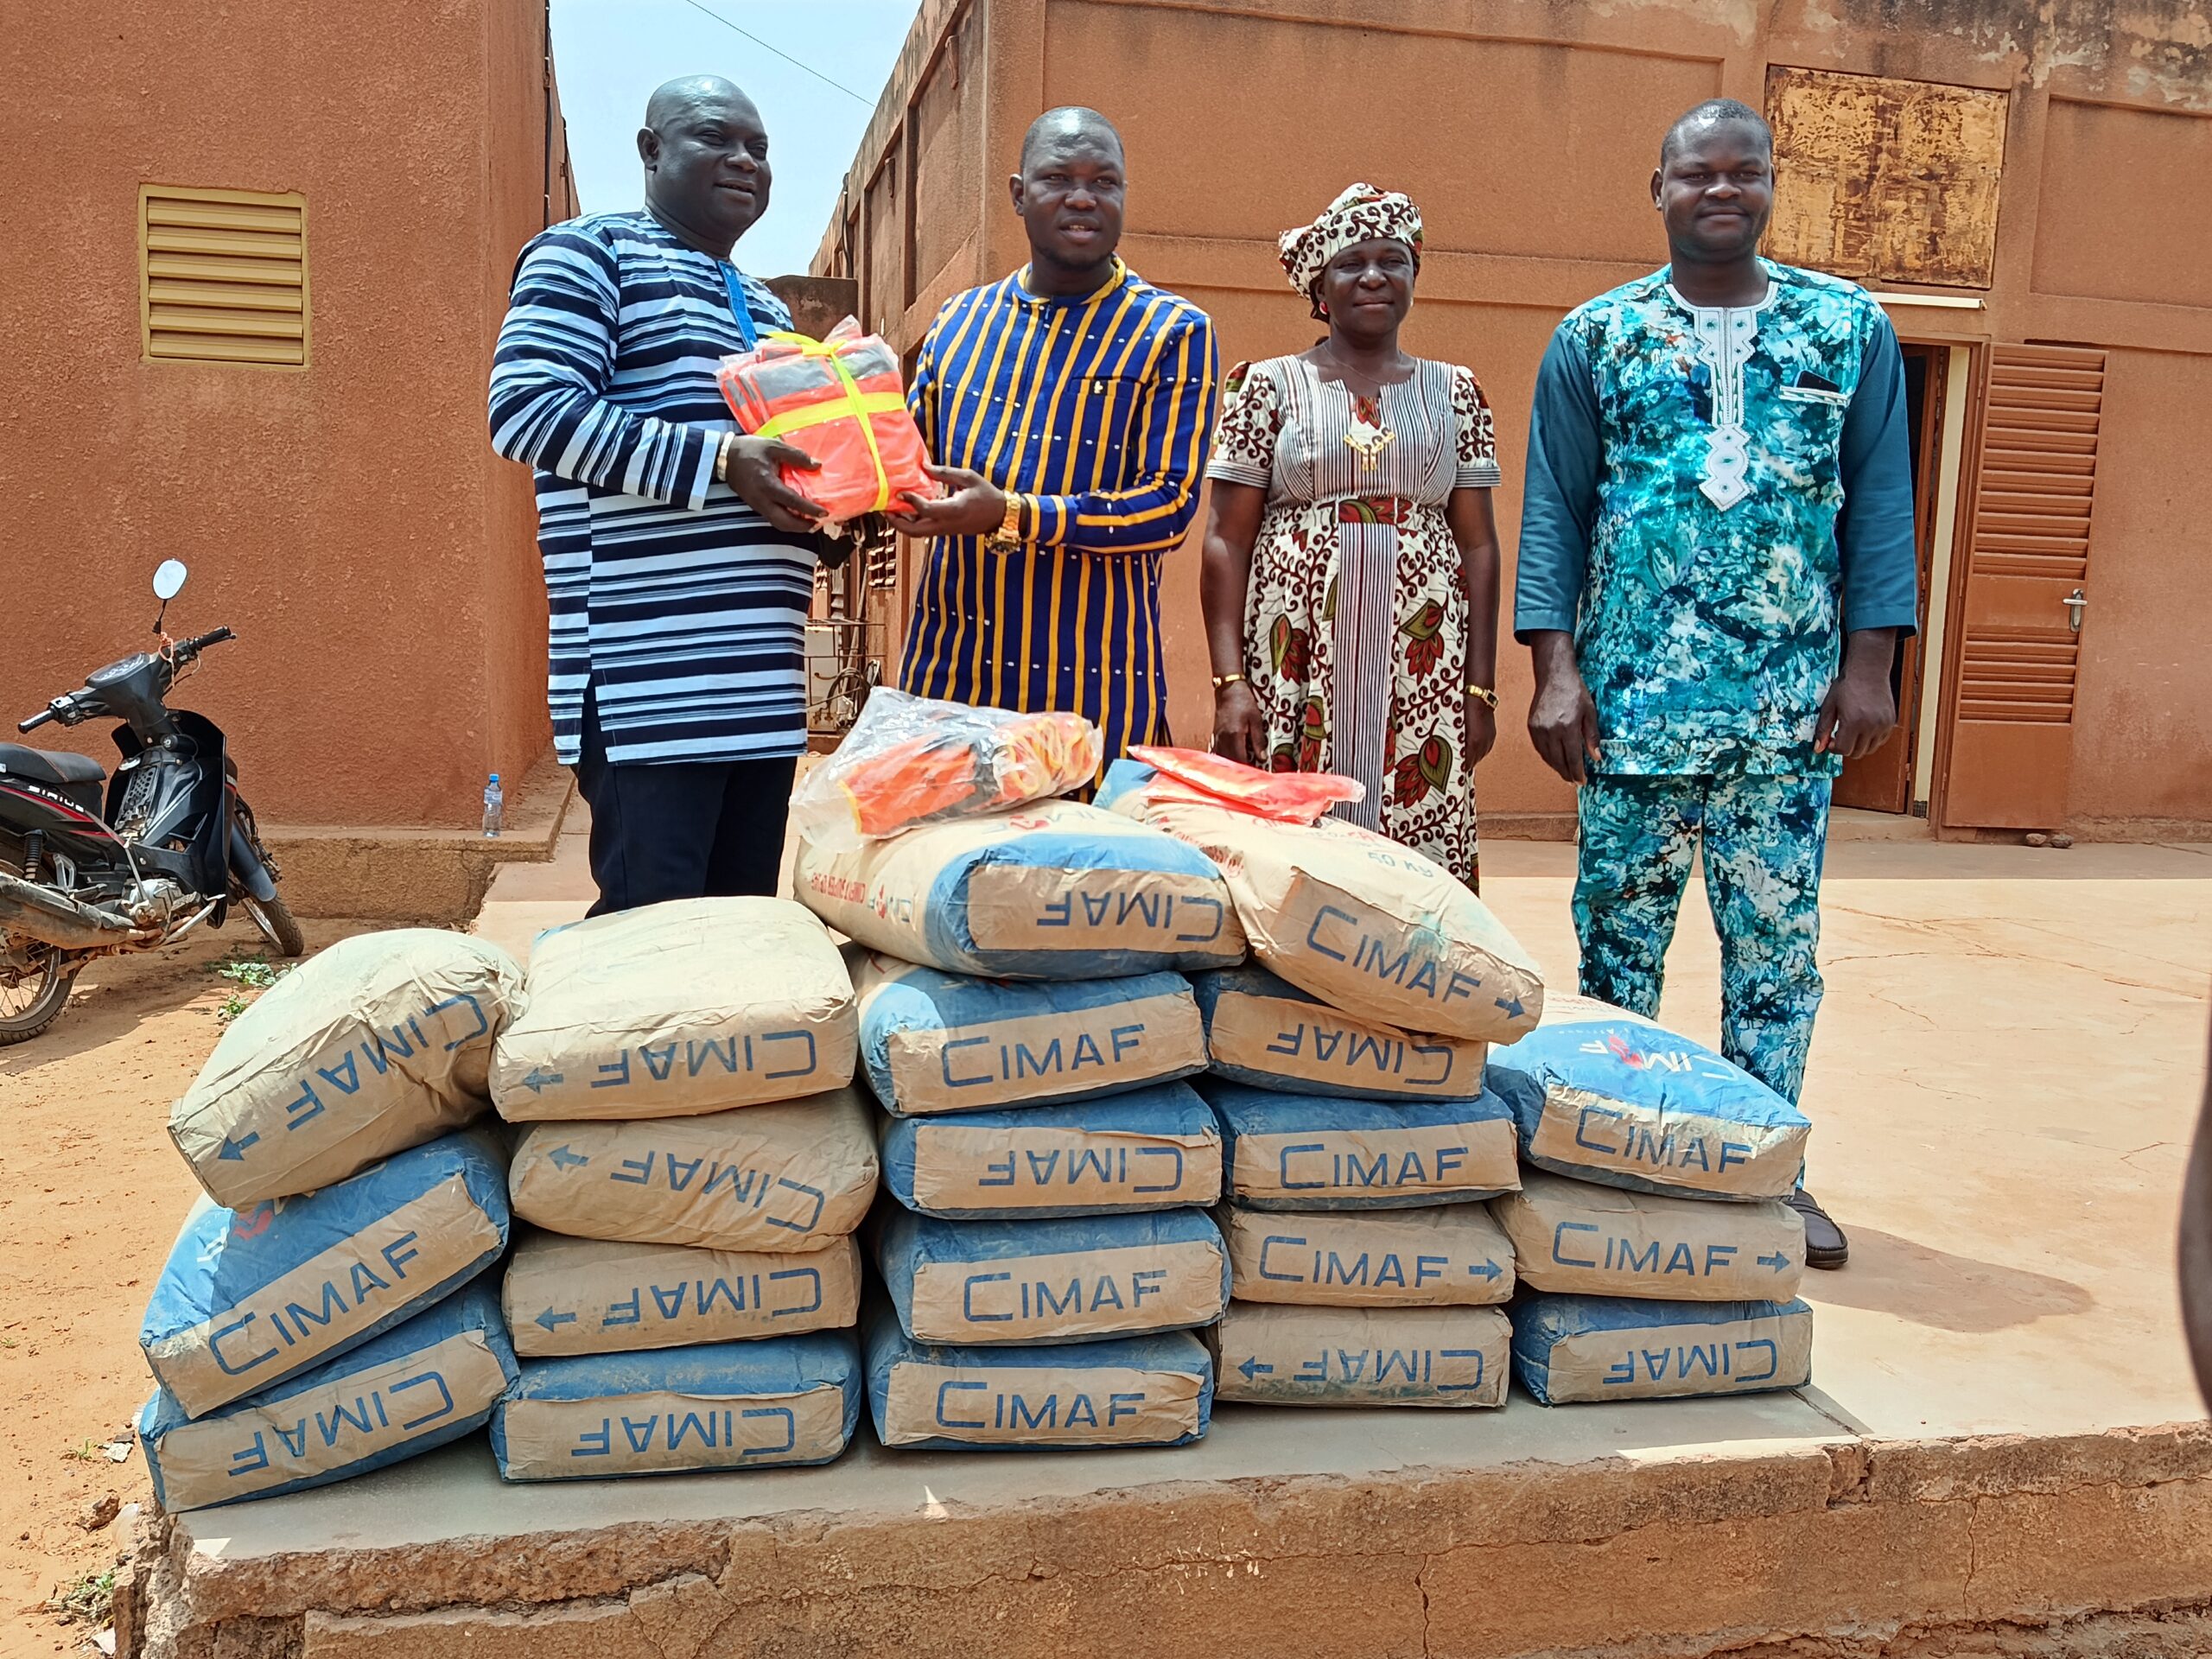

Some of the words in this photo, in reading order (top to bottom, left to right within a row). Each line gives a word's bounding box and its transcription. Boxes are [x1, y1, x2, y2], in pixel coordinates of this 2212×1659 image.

[1037, 892, 1224, 943] CIMAF
[1306, 905, 1481, 1003] CIMAF
[287, 993, 488, 1131] CIMAF
[591, 1029, 817, 1088] CIMAF
[943, 1024, 1145, 1087] CIMAF
[1267, 1023, 1453, 1084] CIMAF
[1280, 1144, 1469, 1188] CIMAF
[1577, 1106, 1752, 1173] CIMAF
[610, 1150, 824, 1233] CIMAF
[978, 1147, 1183, 1192] CIMAF
[1260, 1236, 1448, 1287] CIMAF
[1553, 1222, 1738, 1275] CIMAF
[209, 1231, 418, 1376] CIMAF
[603, 1268, 822, 1325] CIMAF
[963, 1269, 1166, 1322] CIMAF
[1294, 1349, 1484, 1391] CIMAF
[1603, 1338, 1777, 1383] CIMAF
[227, 1371, 454, 1477] CIMAF
[571, 1408, 795, 1456] CIMAF
[936, 1381, 1145, 1429] CIMAF
